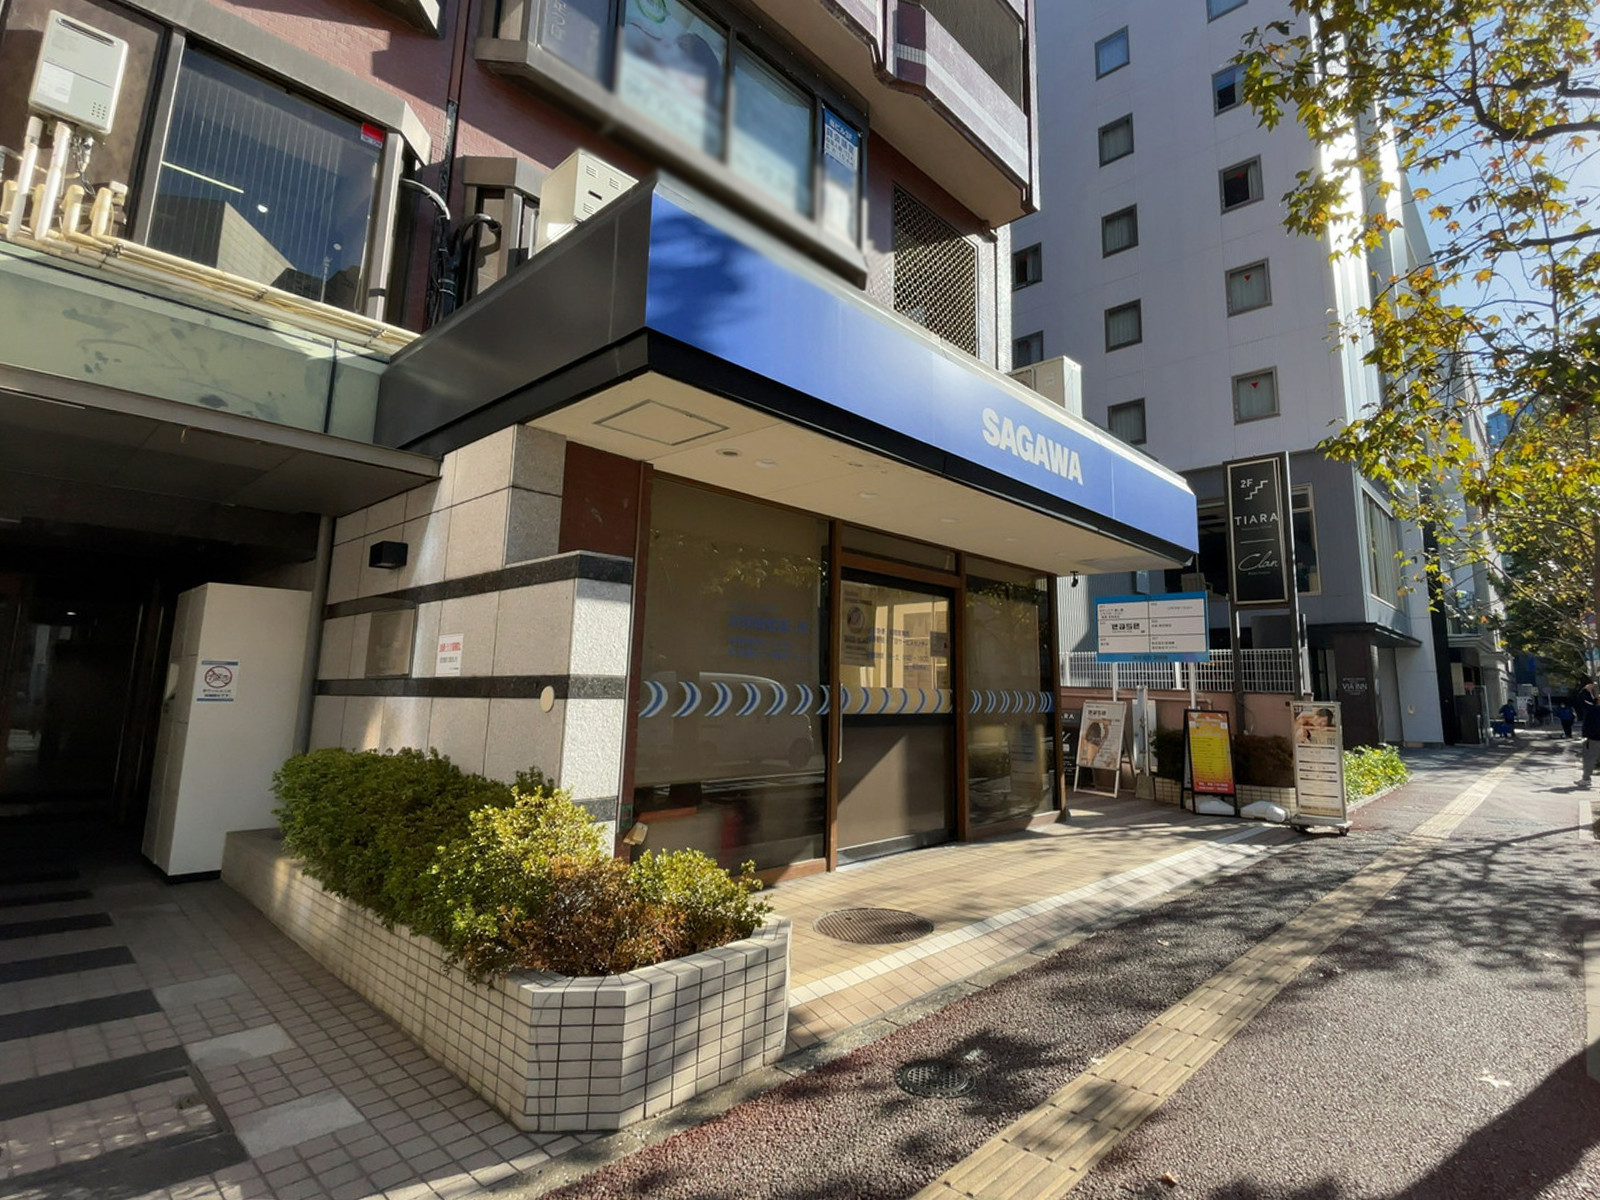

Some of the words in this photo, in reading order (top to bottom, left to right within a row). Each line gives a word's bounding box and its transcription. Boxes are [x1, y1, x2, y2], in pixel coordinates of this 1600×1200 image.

[982, 407, 1083, 486] SAGAWA
[1240, 479, 1253, 488] 2F
[1234, 512, 1279, 526] TIARA
[1238, 550, 1279, 572] Clan
